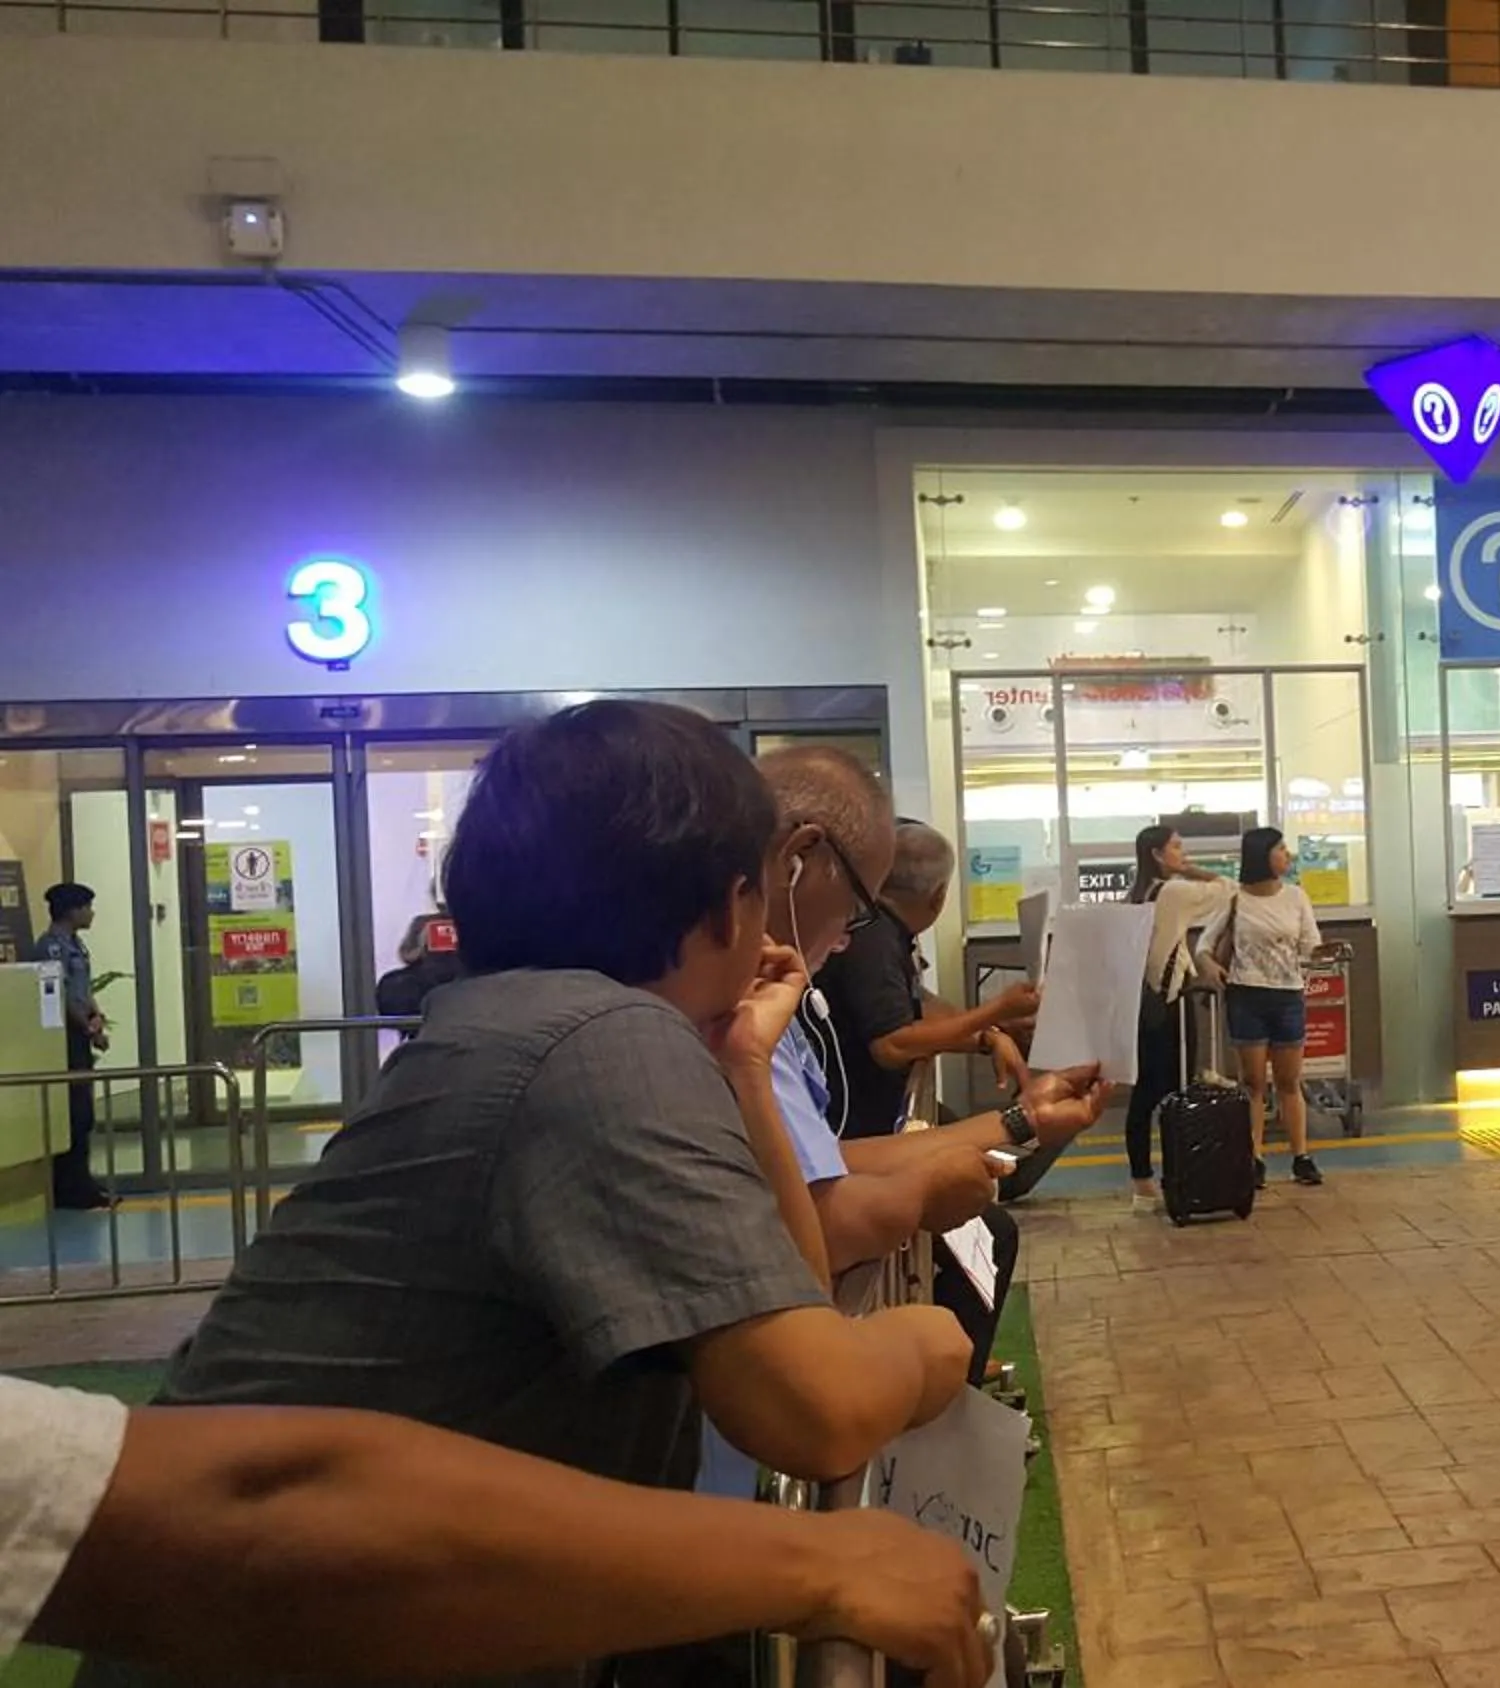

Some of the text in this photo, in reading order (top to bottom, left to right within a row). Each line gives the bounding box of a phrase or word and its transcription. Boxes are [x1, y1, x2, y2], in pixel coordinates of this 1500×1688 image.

[285, 558, 373, 664] 3
[1079, 873, 1126, 889] EXIT 1
